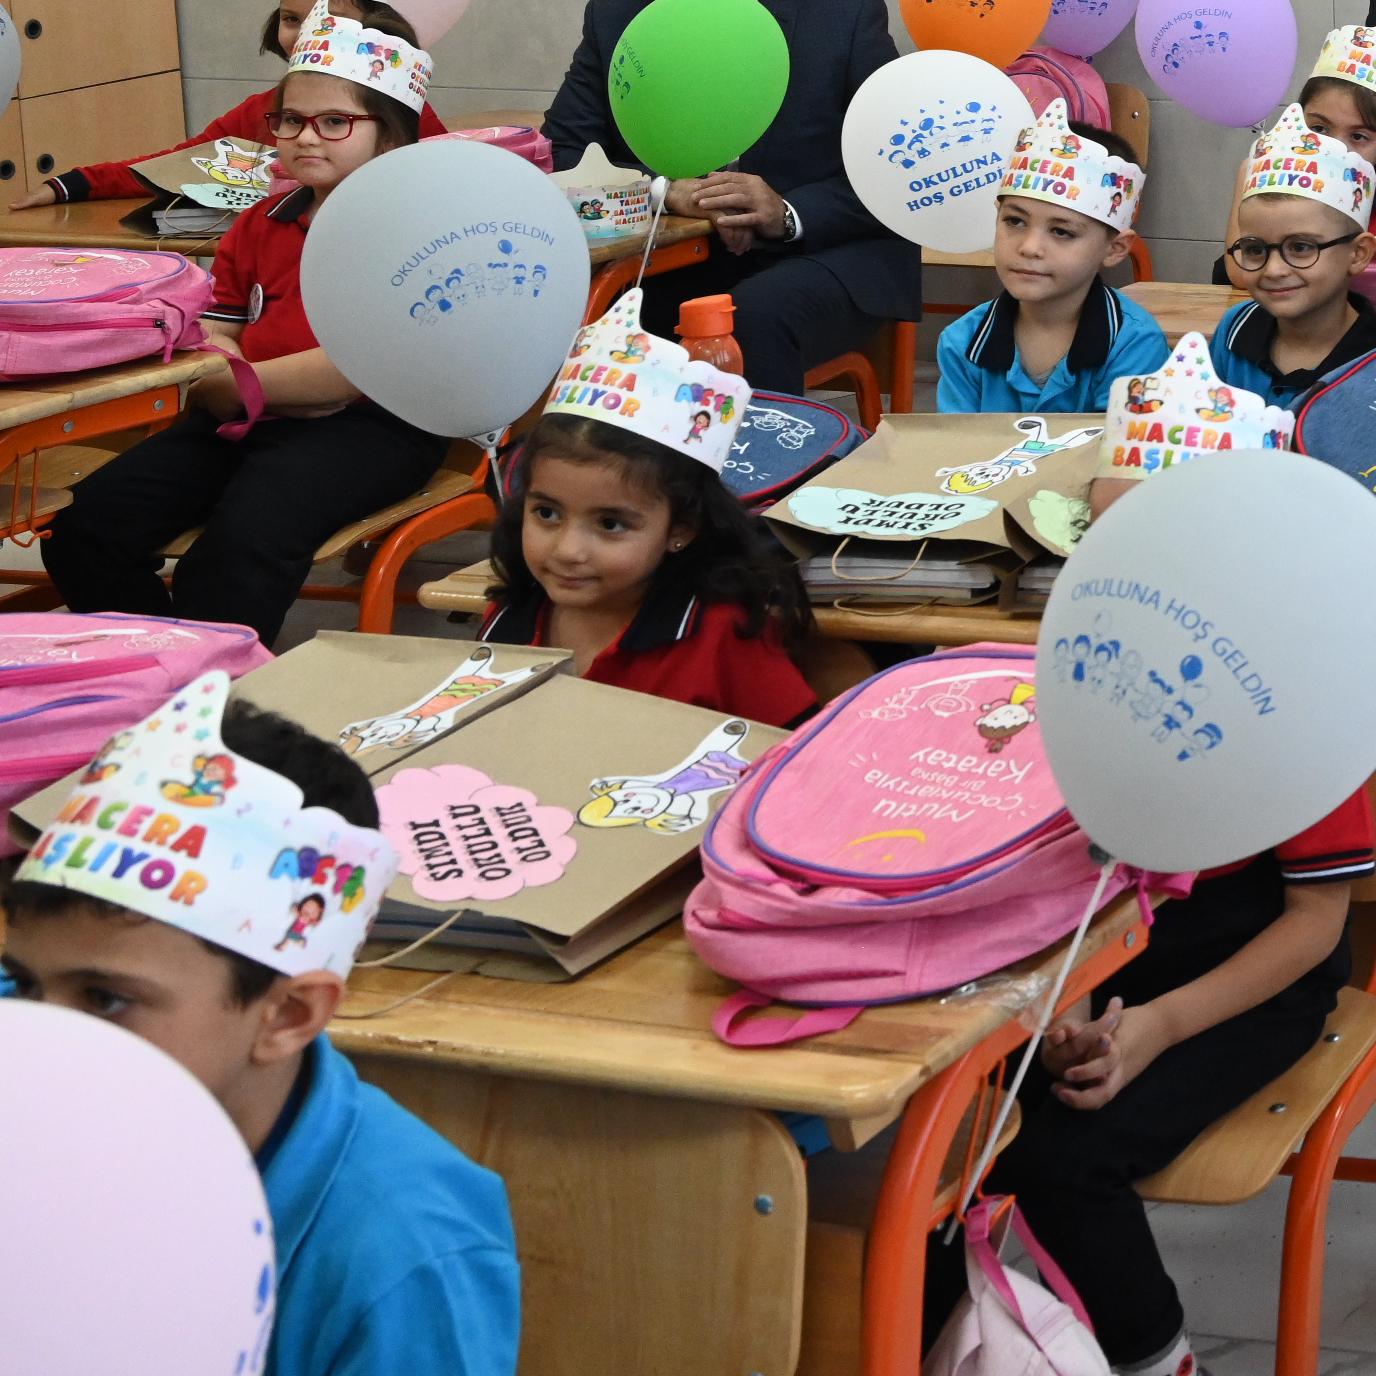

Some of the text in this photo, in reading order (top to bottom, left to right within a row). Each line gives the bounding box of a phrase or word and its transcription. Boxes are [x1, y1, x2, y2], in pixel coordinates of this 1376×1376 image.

[906, 165, 1005, 212] HOŞ GELDİ
[909, 151, 1003, 192] OKULUNA
[390, 221, 555, 287] OKULUNA HOŞ GELDİN
[1125, 420, 1233, 451] MACERA
[836, 503, 961, 521] OKULLU
[861, 498, 965, 511] OLDUK
[1071, 578, 1276, 716] OKULUNA HOŞ GELDİN
[909, 747, 1033, 784] Karatay
[872, 798, 975, 823] Mutlu
[447, 803, 512, 882] OKULLU
[495, 801, 552, 864] OLDUK
